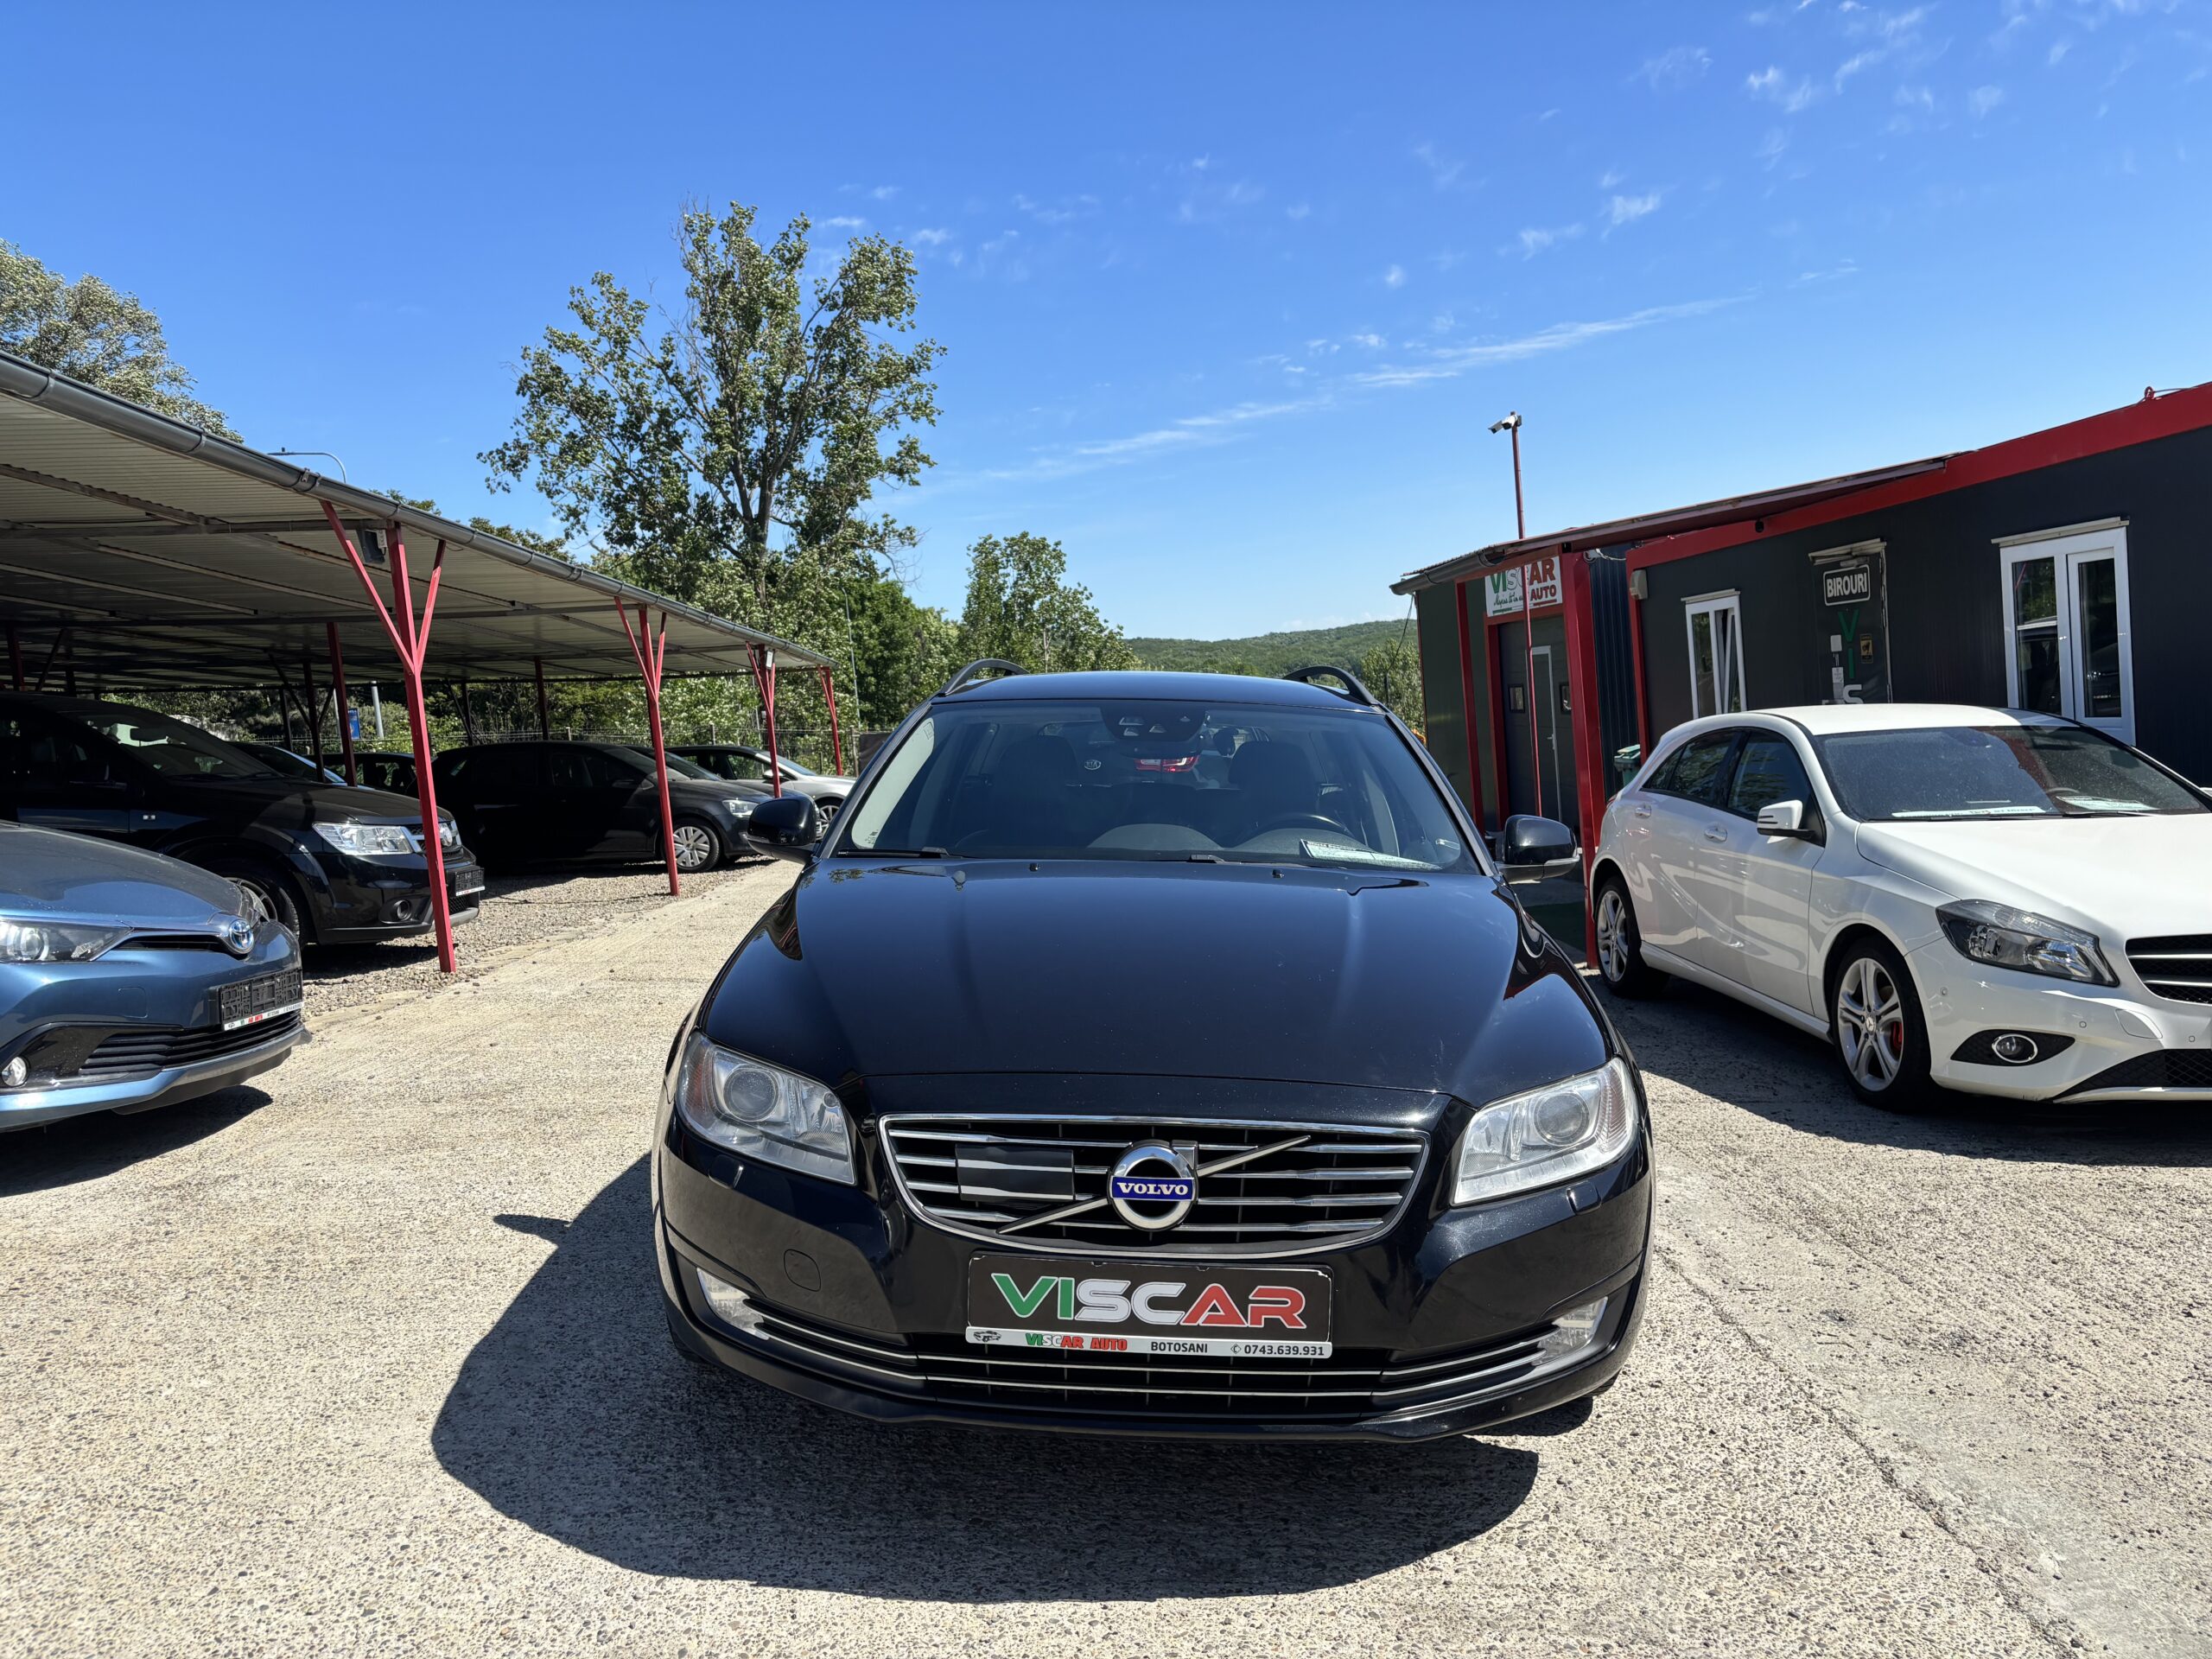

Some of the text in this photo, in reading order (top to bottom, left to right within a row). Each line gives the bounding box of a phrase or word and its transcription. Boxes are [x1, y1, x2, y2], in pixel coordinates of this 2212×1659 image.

[1530, 585, 1557, 601] AUTO
[1827, 573, 1867, 597] BIROURI
[1116, 1182, 1188, 1196] VOLVO
[991, 1272, 1306, 1330] VISCAR
[1025, 1332, 1325, 1357] VISCAR AUTO BOTOSANI 0743.639.931
